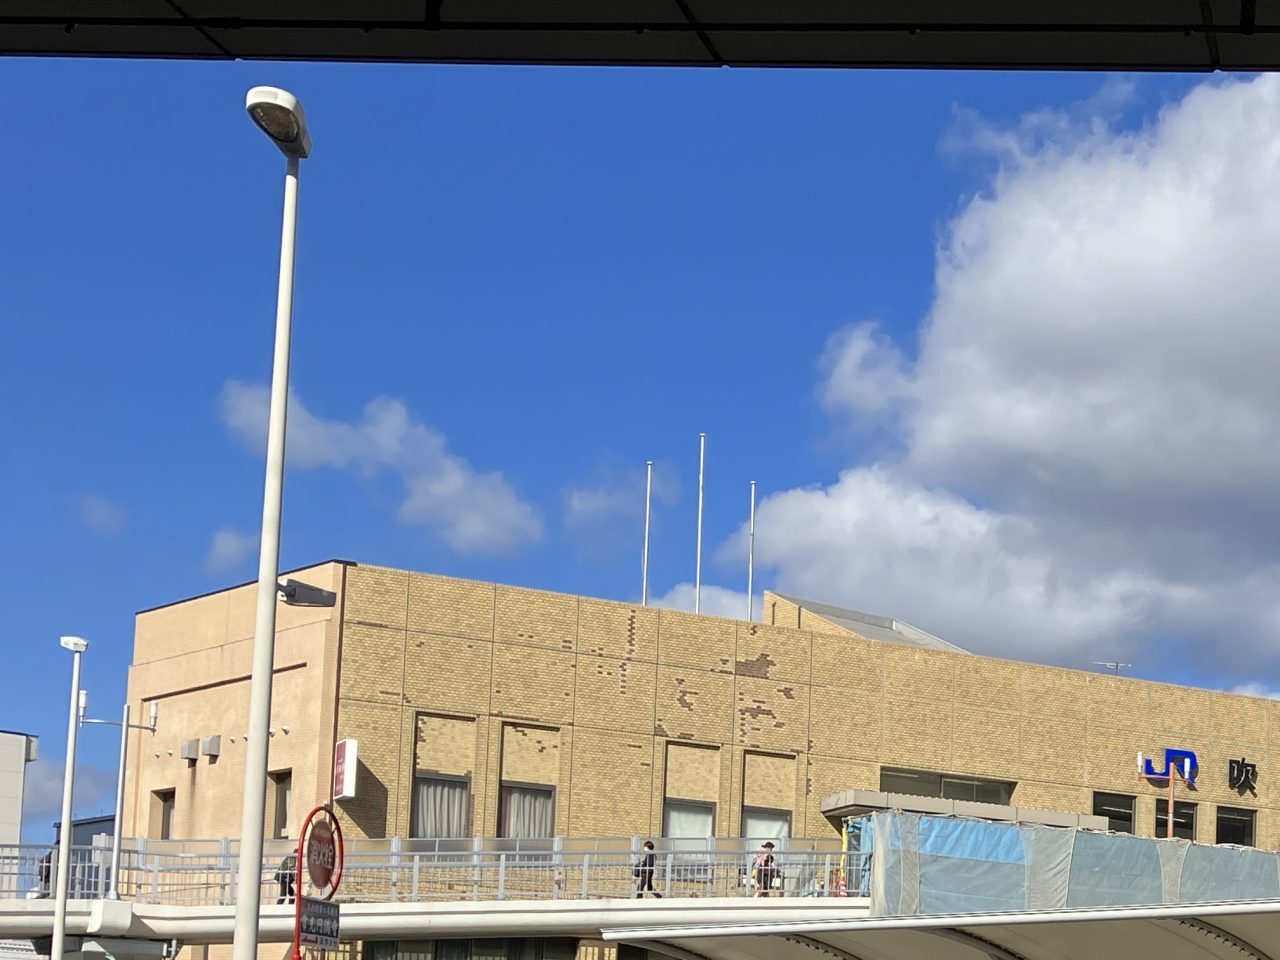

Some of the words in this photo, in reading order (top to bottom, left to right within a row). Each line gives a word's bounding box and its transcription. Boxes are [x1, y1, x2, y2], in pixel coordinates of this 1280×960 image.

[1144, 748, 1198, 785] JR
[310, 840, 334, 869] 消火栓
